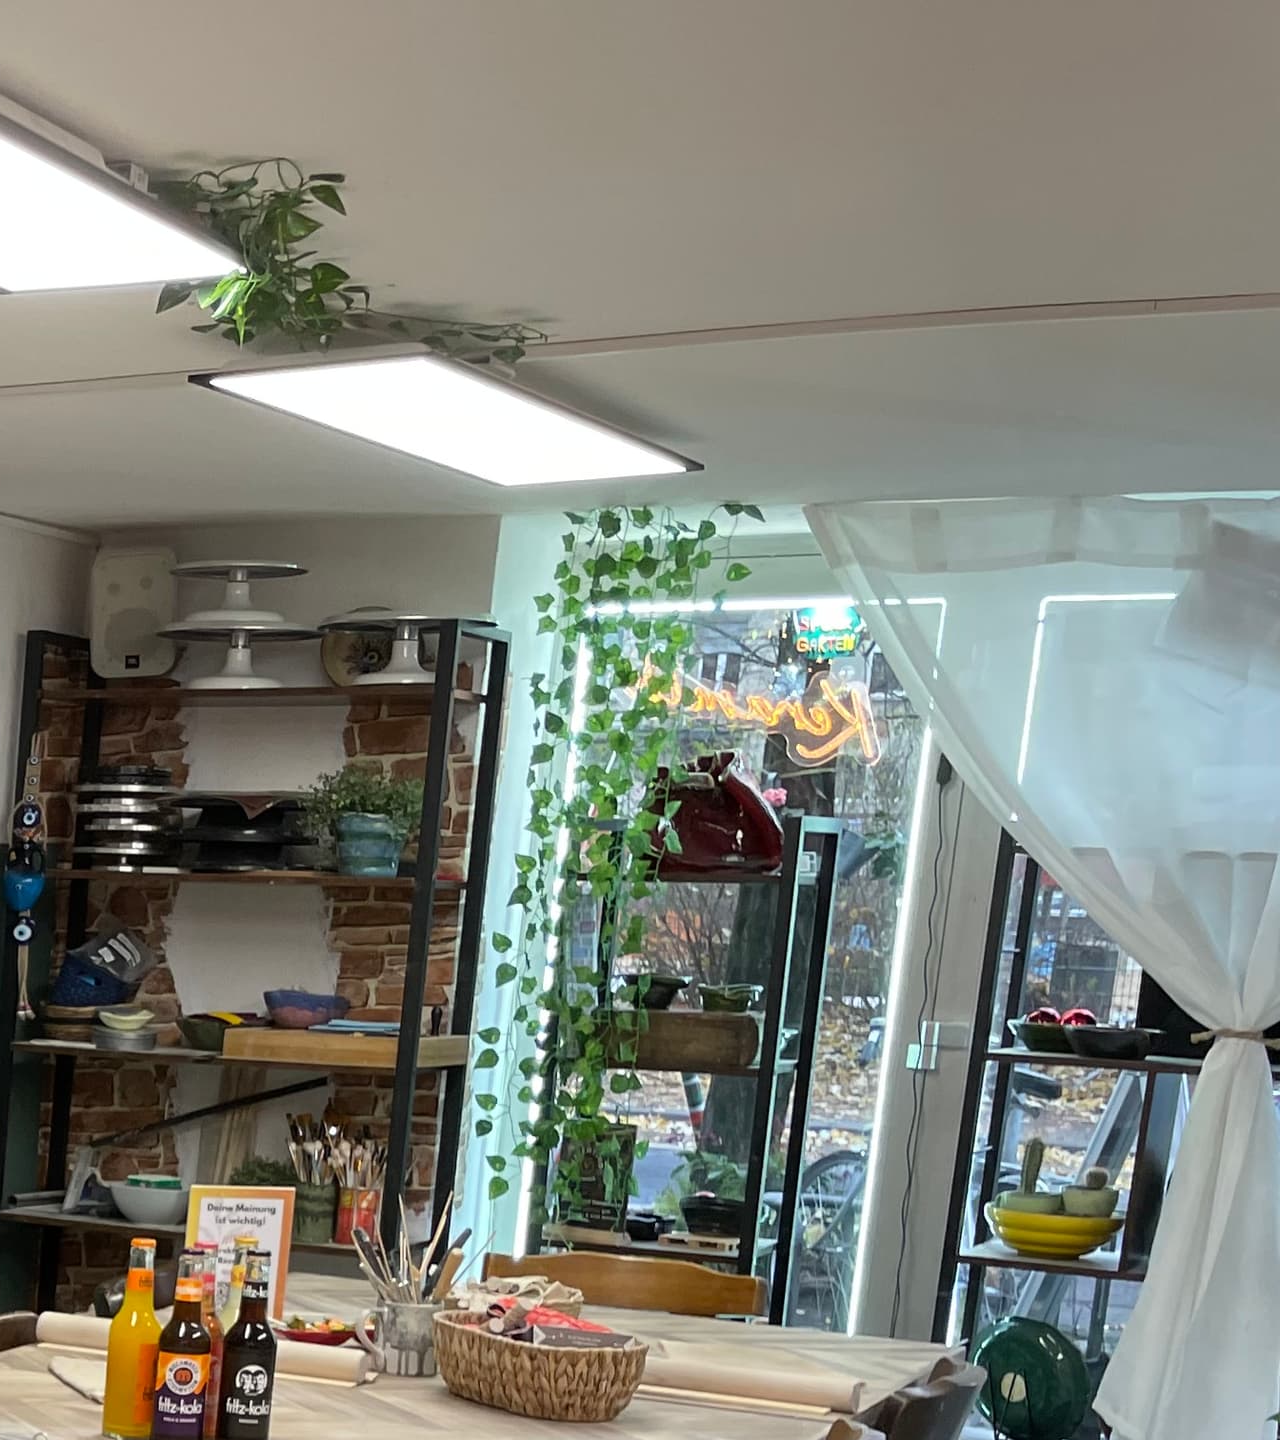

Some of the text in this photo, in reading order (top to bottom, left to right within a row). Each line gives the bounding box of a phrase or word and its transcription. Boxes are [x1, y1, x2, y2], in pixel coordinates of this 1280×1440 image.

[207, 1202, 277, 1216] Deine Meinung
[215, 1216, 227, 1225] ist
[157, 1396, 203, 1415] fritz-kola
[225, 1396, 270, 1416] fritz-kola
